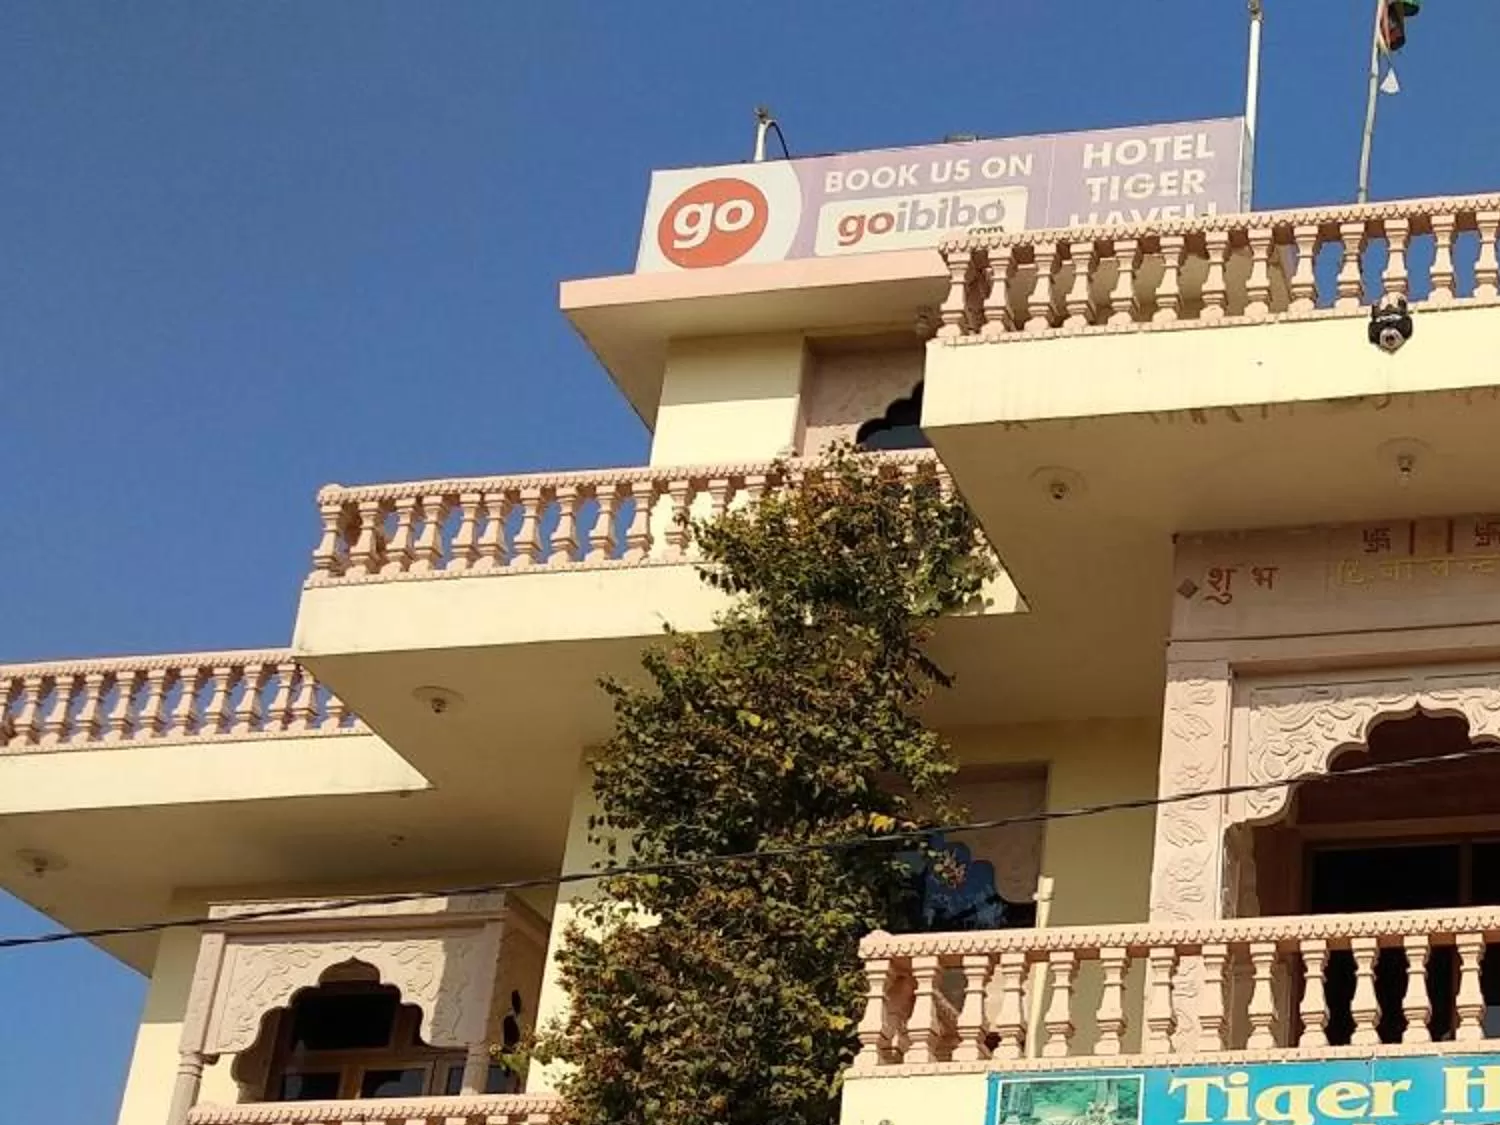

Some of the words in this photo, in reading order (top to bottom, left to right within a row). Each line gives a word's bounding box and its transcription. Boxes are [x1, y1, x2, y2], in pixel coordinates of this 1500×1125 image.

[1083, 133, 1215, 169] HOTEL
[824, 163, 920, 193] BOOK
[930, 157, 970, 184] US
[981, 153, 1033, 181] ON
[1085, 167, 1206, 204] TIGER
[673, 198, 756, 250] go
[837, 197, 1006, 247] goibibo
